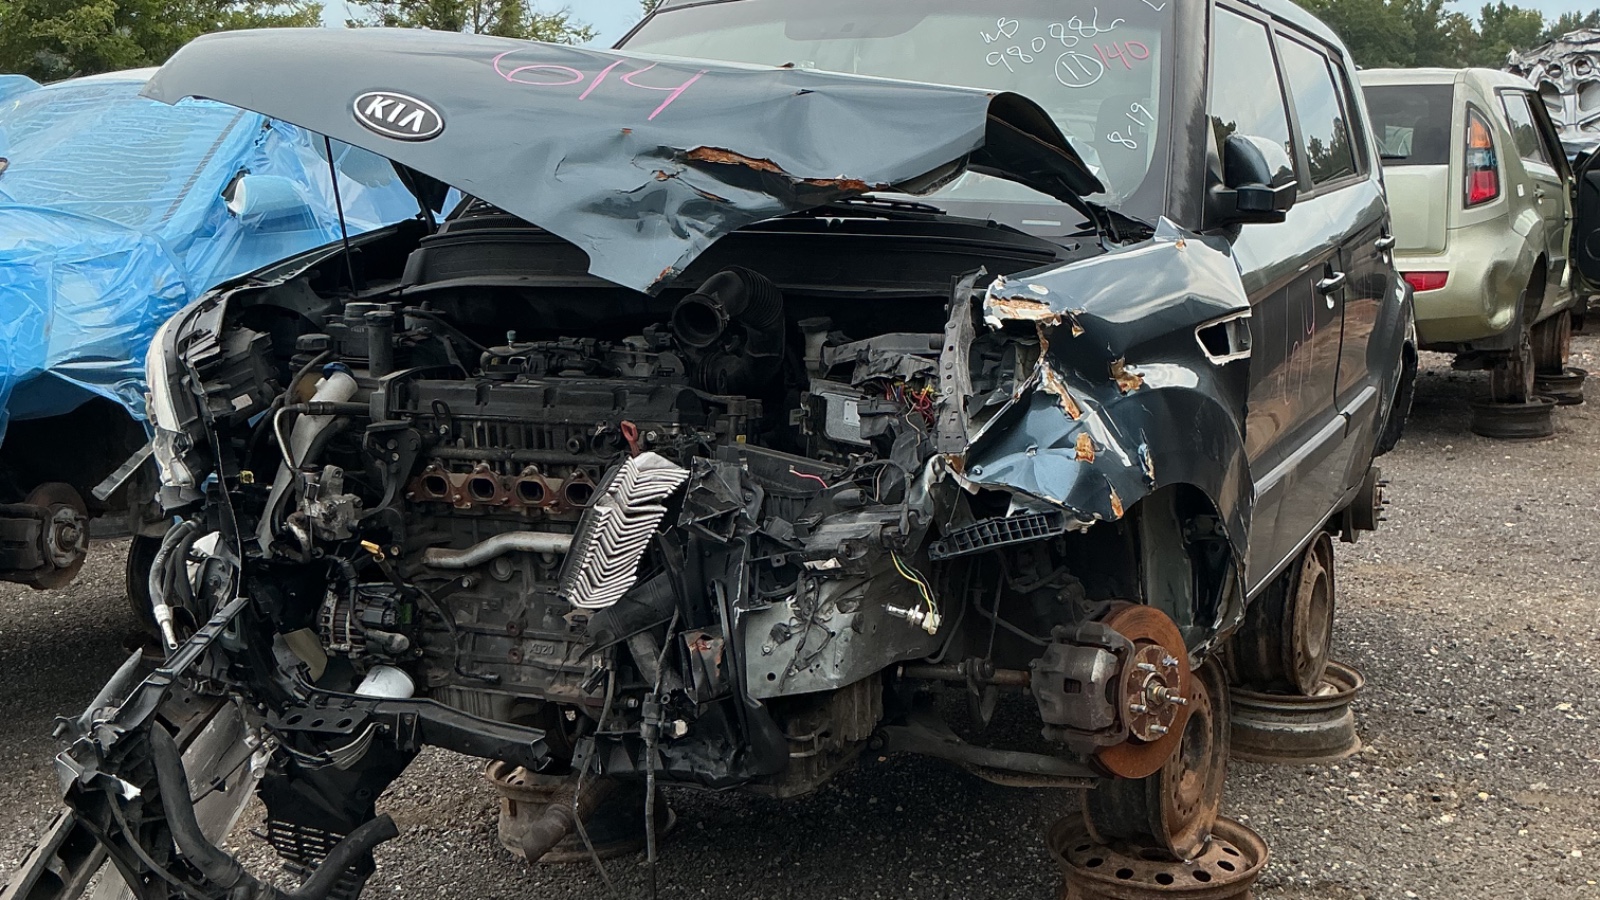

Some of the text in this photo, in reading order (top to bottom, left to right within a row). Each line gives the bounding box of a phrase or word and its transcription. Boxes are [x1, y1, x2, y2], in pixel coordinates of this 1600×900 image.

[1093, 41, 1150, 70] 140
[492, 48, 710, 121] 614
[364, 95, 425, 133] KIA
[1107, 102, 1154, 149] 8-19
